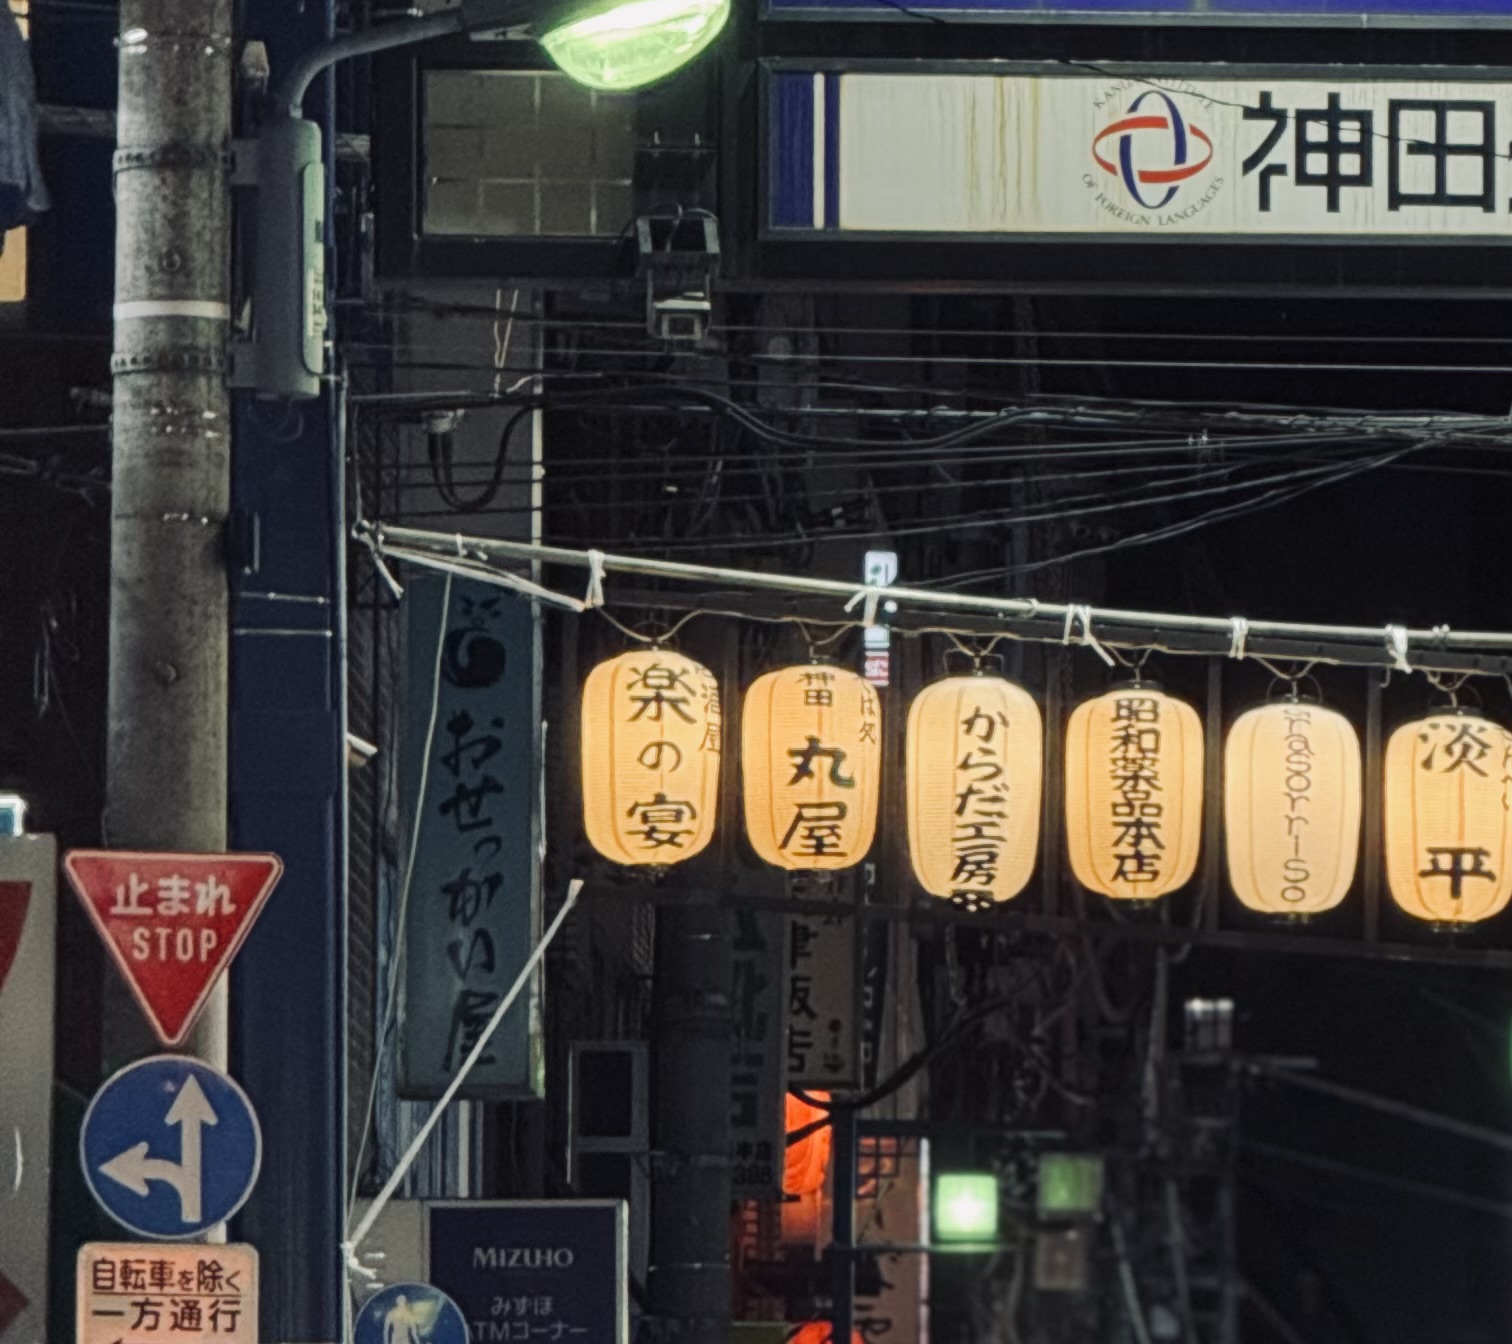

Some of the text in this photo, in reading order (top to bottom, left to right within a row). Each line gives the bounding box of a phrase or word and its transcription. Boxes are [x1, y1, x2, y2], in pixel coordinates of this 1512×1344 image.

[1094, 191, 1152, 226] FOREIGN
[1156, 175, 1225, 227] LANGUAGES
[799, 671, 836, 707] 神田
[626, 662, 698, 850] 楽の宴
[779, 735, 857, 858] 丸屋
[948, 704, 1012, 887] からだ工房
[1109, 698, 1165, 885] 昭和薬品本店
[1417, 722, 1497, 900] 淡平
[110, 872, 236, 917] 止まれ
[132, 923, 220, 963] STOP
[91, 1258, 242, 1294] 自転車を除く
[472, 1246, 575, 1268] MIZUHO
[91, 1296, 243, 1334] 一方通行
[490, 1295, 554, 1315] みずほ
